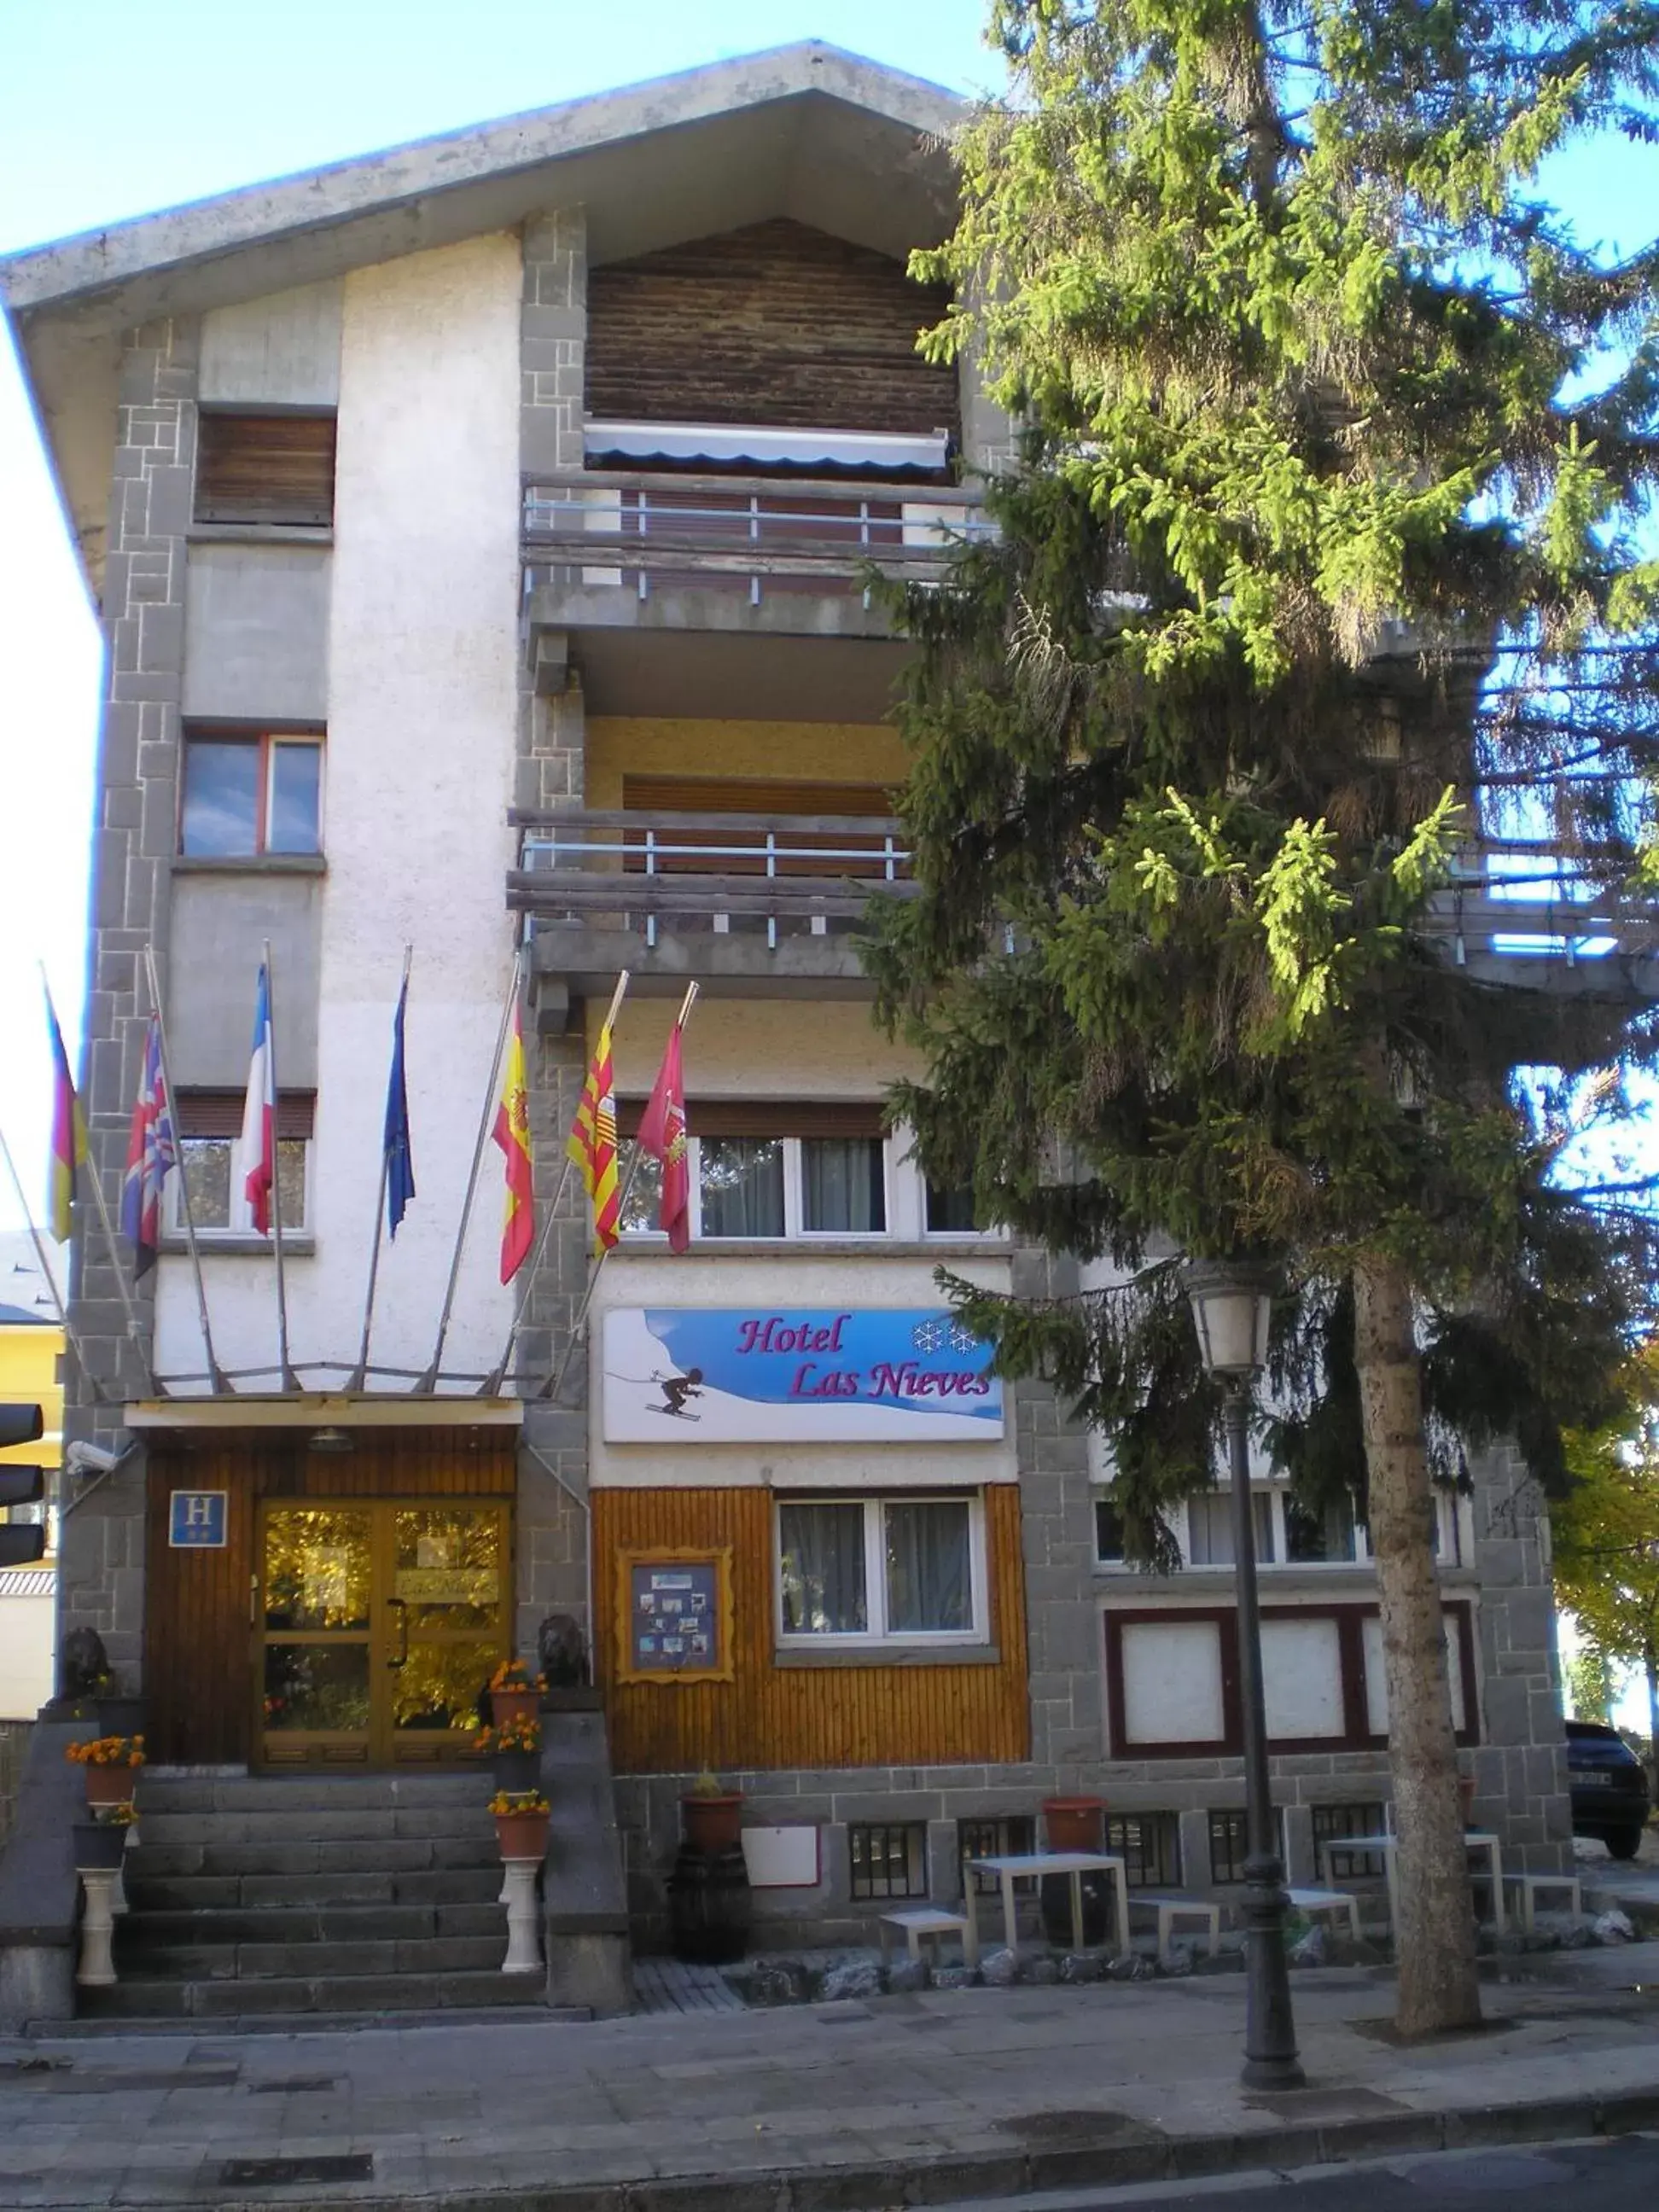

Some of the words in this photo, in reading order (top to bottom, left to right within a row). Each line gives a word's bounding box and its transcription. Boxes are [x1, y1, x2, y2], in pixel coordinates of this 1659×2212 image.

[735, 1314, 853, 1353] Hotel
[789, 1363, 860, 1397] Las
[867, 1362, 990, 1398] Nieves
[184, 1496, 213, 1526] H
